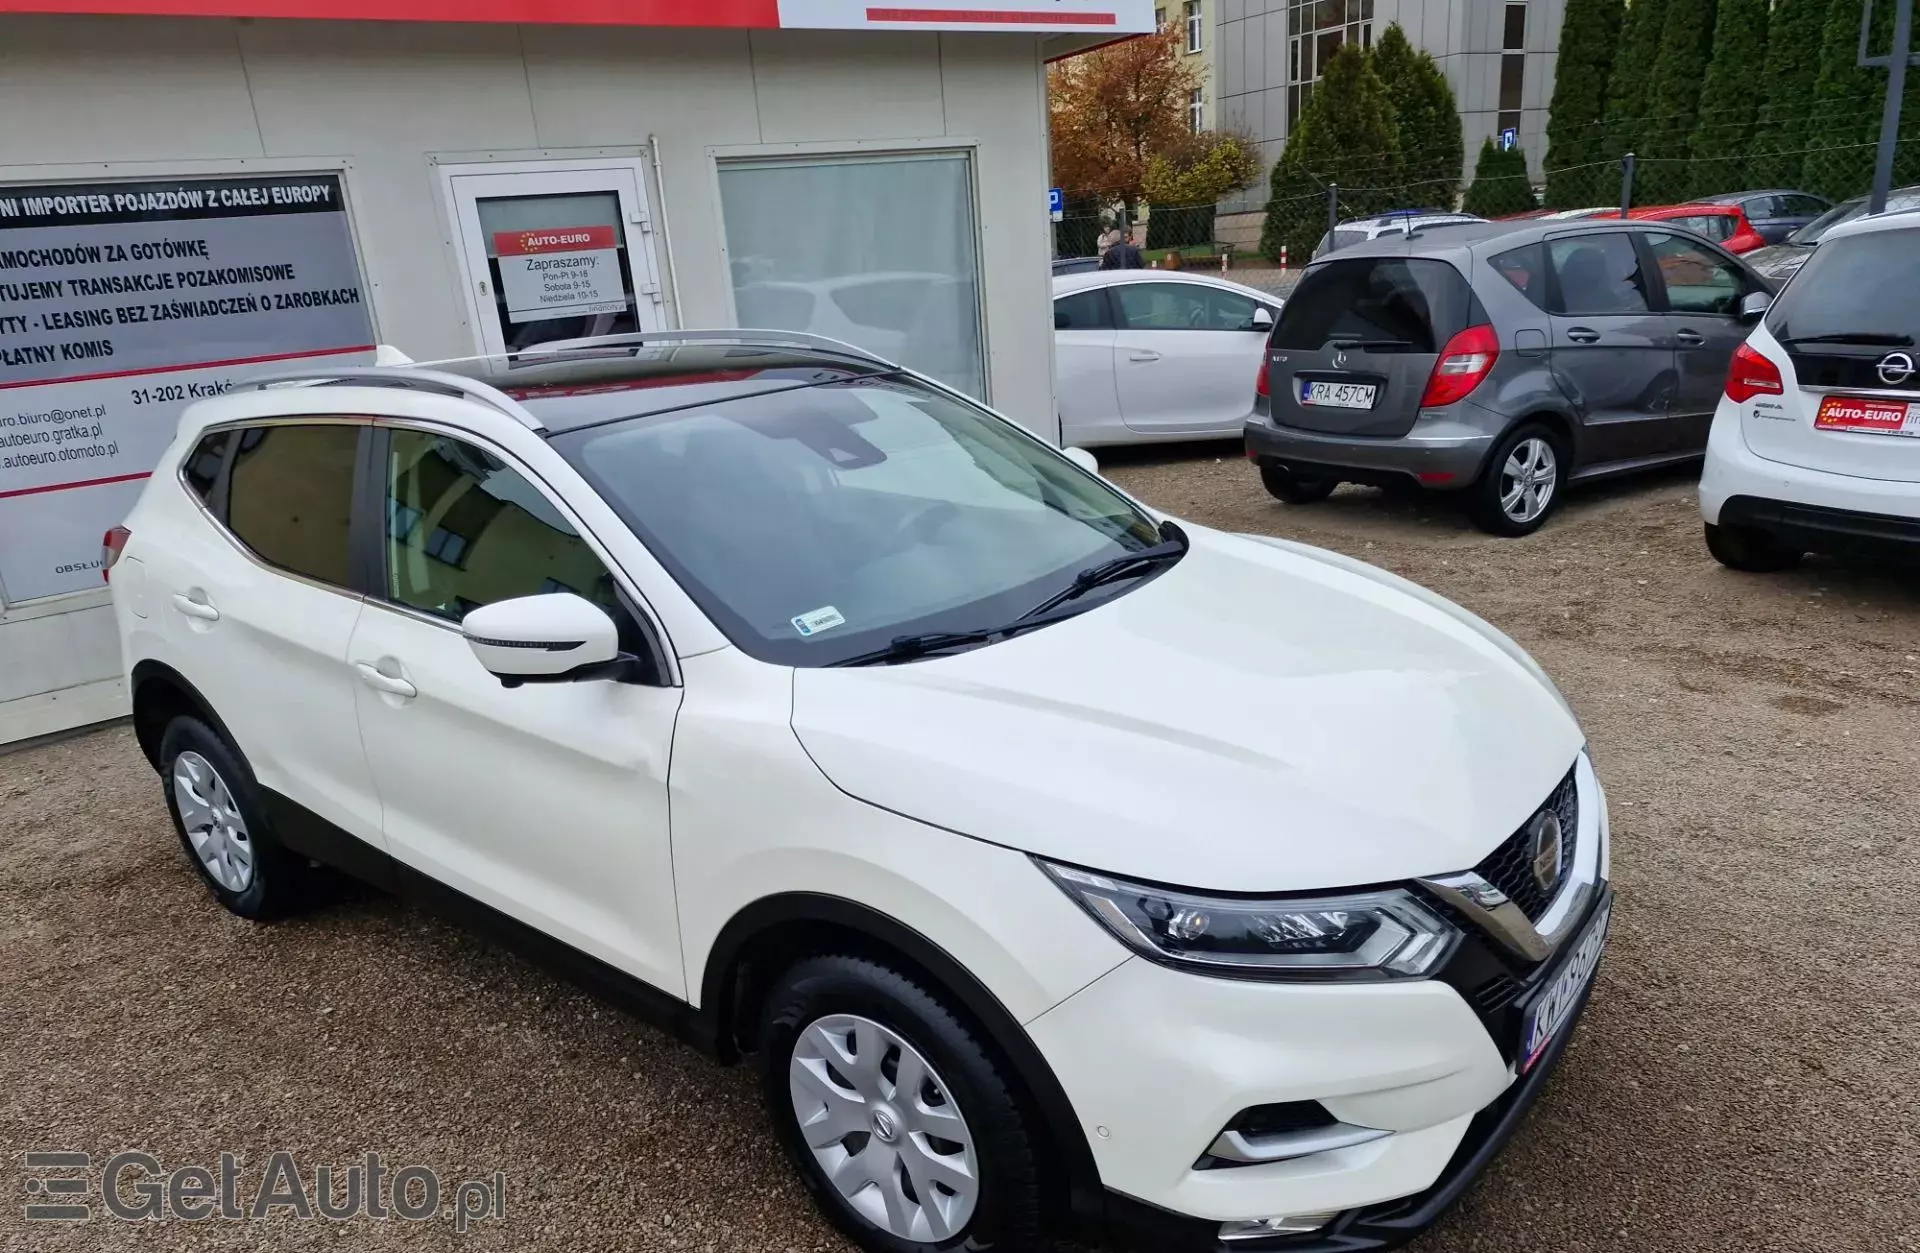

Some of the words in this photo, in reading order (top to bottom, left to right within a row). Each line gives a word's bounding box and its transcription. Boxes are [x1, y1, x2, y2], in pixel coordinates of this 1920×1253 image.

[0, 198, 20, 217] NI
[22, 194, 113, 216] IMPORTER
[114, 187, 203, 212] POJAZDÓW
[205, 190, 218, 208] Z
[220, 187, 268, 208] CAŁEJ
[271, 184, 330, 204] EUROPY
[527, 233, 590, 246] AUTO-EURO
[0, 243, 101, 269] MOCHODÓW
[104, 244, 128, 262] ZA
[130, 238, 210, 260] GOTÓWKĘ
[525, 255, 600, 272] Zapraszamy:
[68, 272, 174, 297] TRANSAKCJE
[176, 264, 296, 289] POZAKOMISOWE
[544, 282, 572, 292] Sobota
[42, 308, 113, 331] LEASING
[116, 305, 148, 325] BEZ
[150, 292, 259, 321] ZAŚWIADCZEŃ
[261, 295, 272, 312] O
[274, 288, 360, 311] ZAROBKACH
[0, 345, 55, 366] ŁATNY
[60, 339, 114, 361] KOMIS
[131, 385, 185, 404] 31-202
[187, 379, 234, 399] Krakó
[1310, 383, 1331, 401] KRA
[1335, 385, 1374, 404] 457CM
[1826, 408, 1902, 422] AUTO-EURO
[0, 440, 119, 469] .autoeuro.otomoto.pl
[55, 560, 103, 574] OBSŁU
